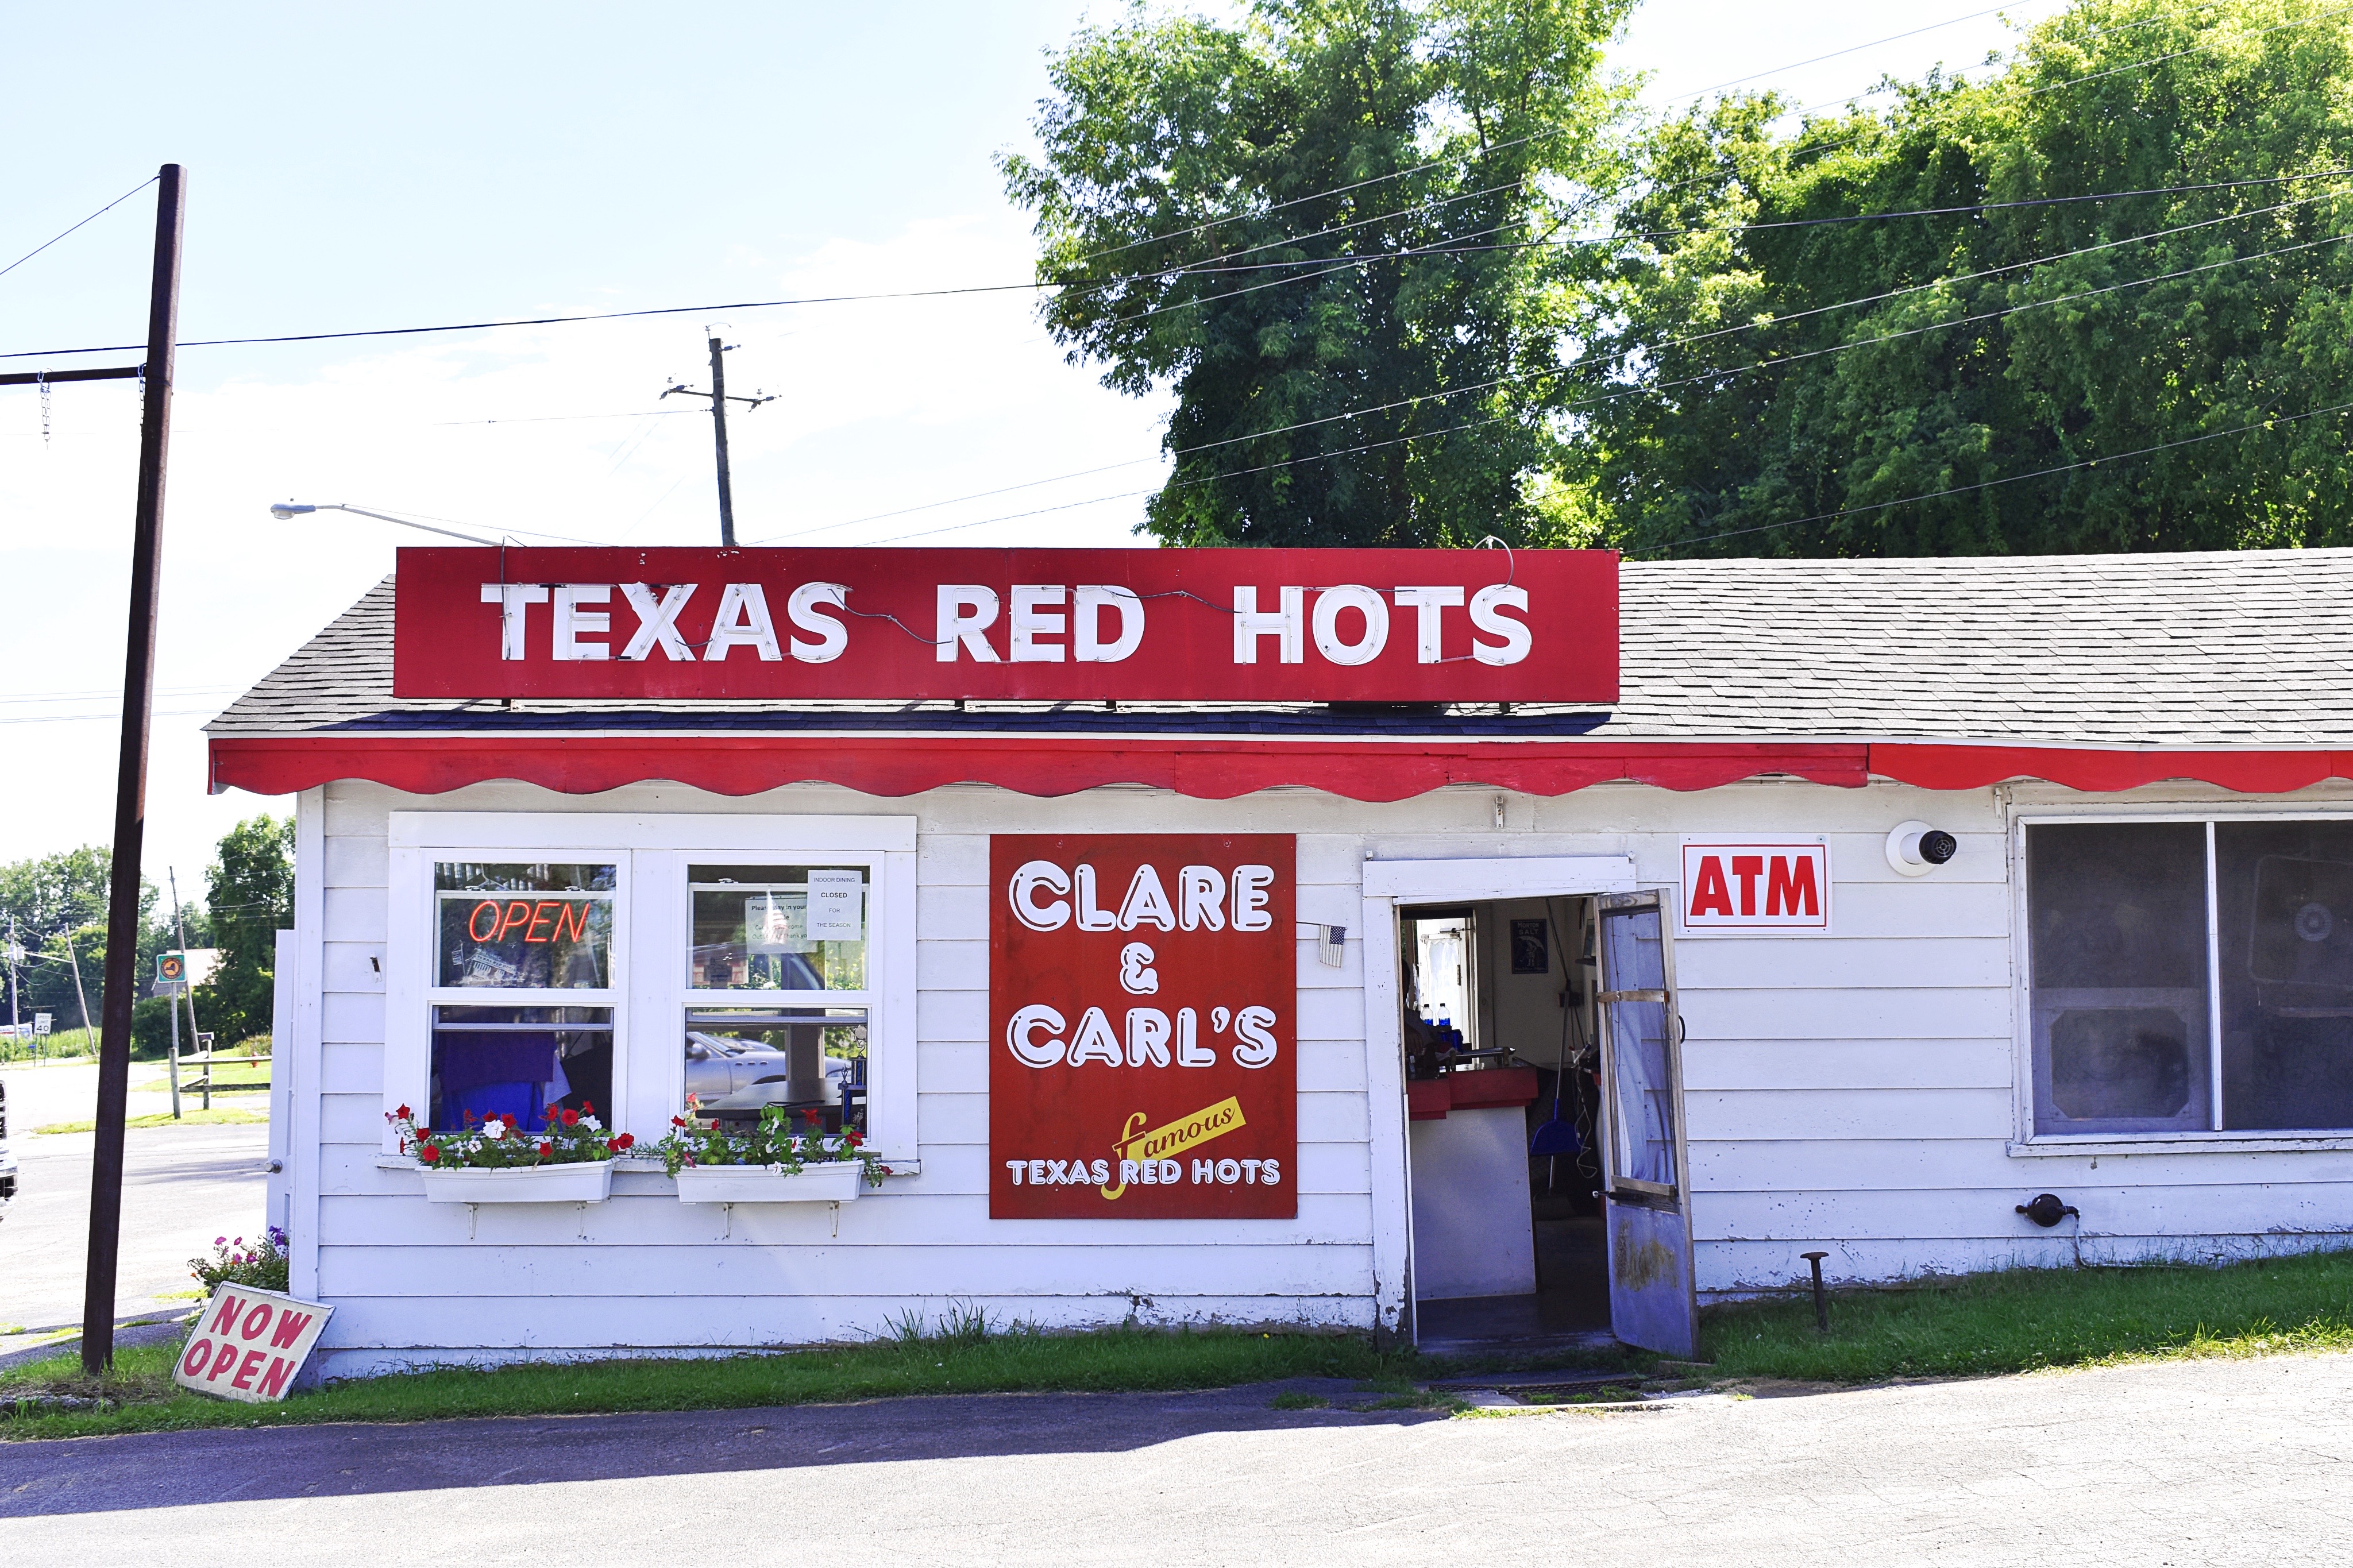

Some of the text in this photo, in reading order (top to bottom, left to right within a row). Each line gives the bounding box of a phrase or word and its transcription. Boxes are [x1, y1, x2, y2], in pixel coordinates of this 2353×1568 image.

[480, 581, 1533, 666] TEXAS RED HOTS
[1008, 860, 1275, 932] CLARE
[1689, 855, 1819, 916] ATM
[469, 900, 591, 943] OPEN
[1119, 941, 1159, 995] &
[1006, 1003, 1278, 1069] CARL'S
[1006, 1157, 1281, 1185] TEXAS RED HOTS
[1101, 1104, 1236, 1200] famous
[209, 1295, 313, 1350] NOW
[183, 1338, 296, 1397] OPEN
